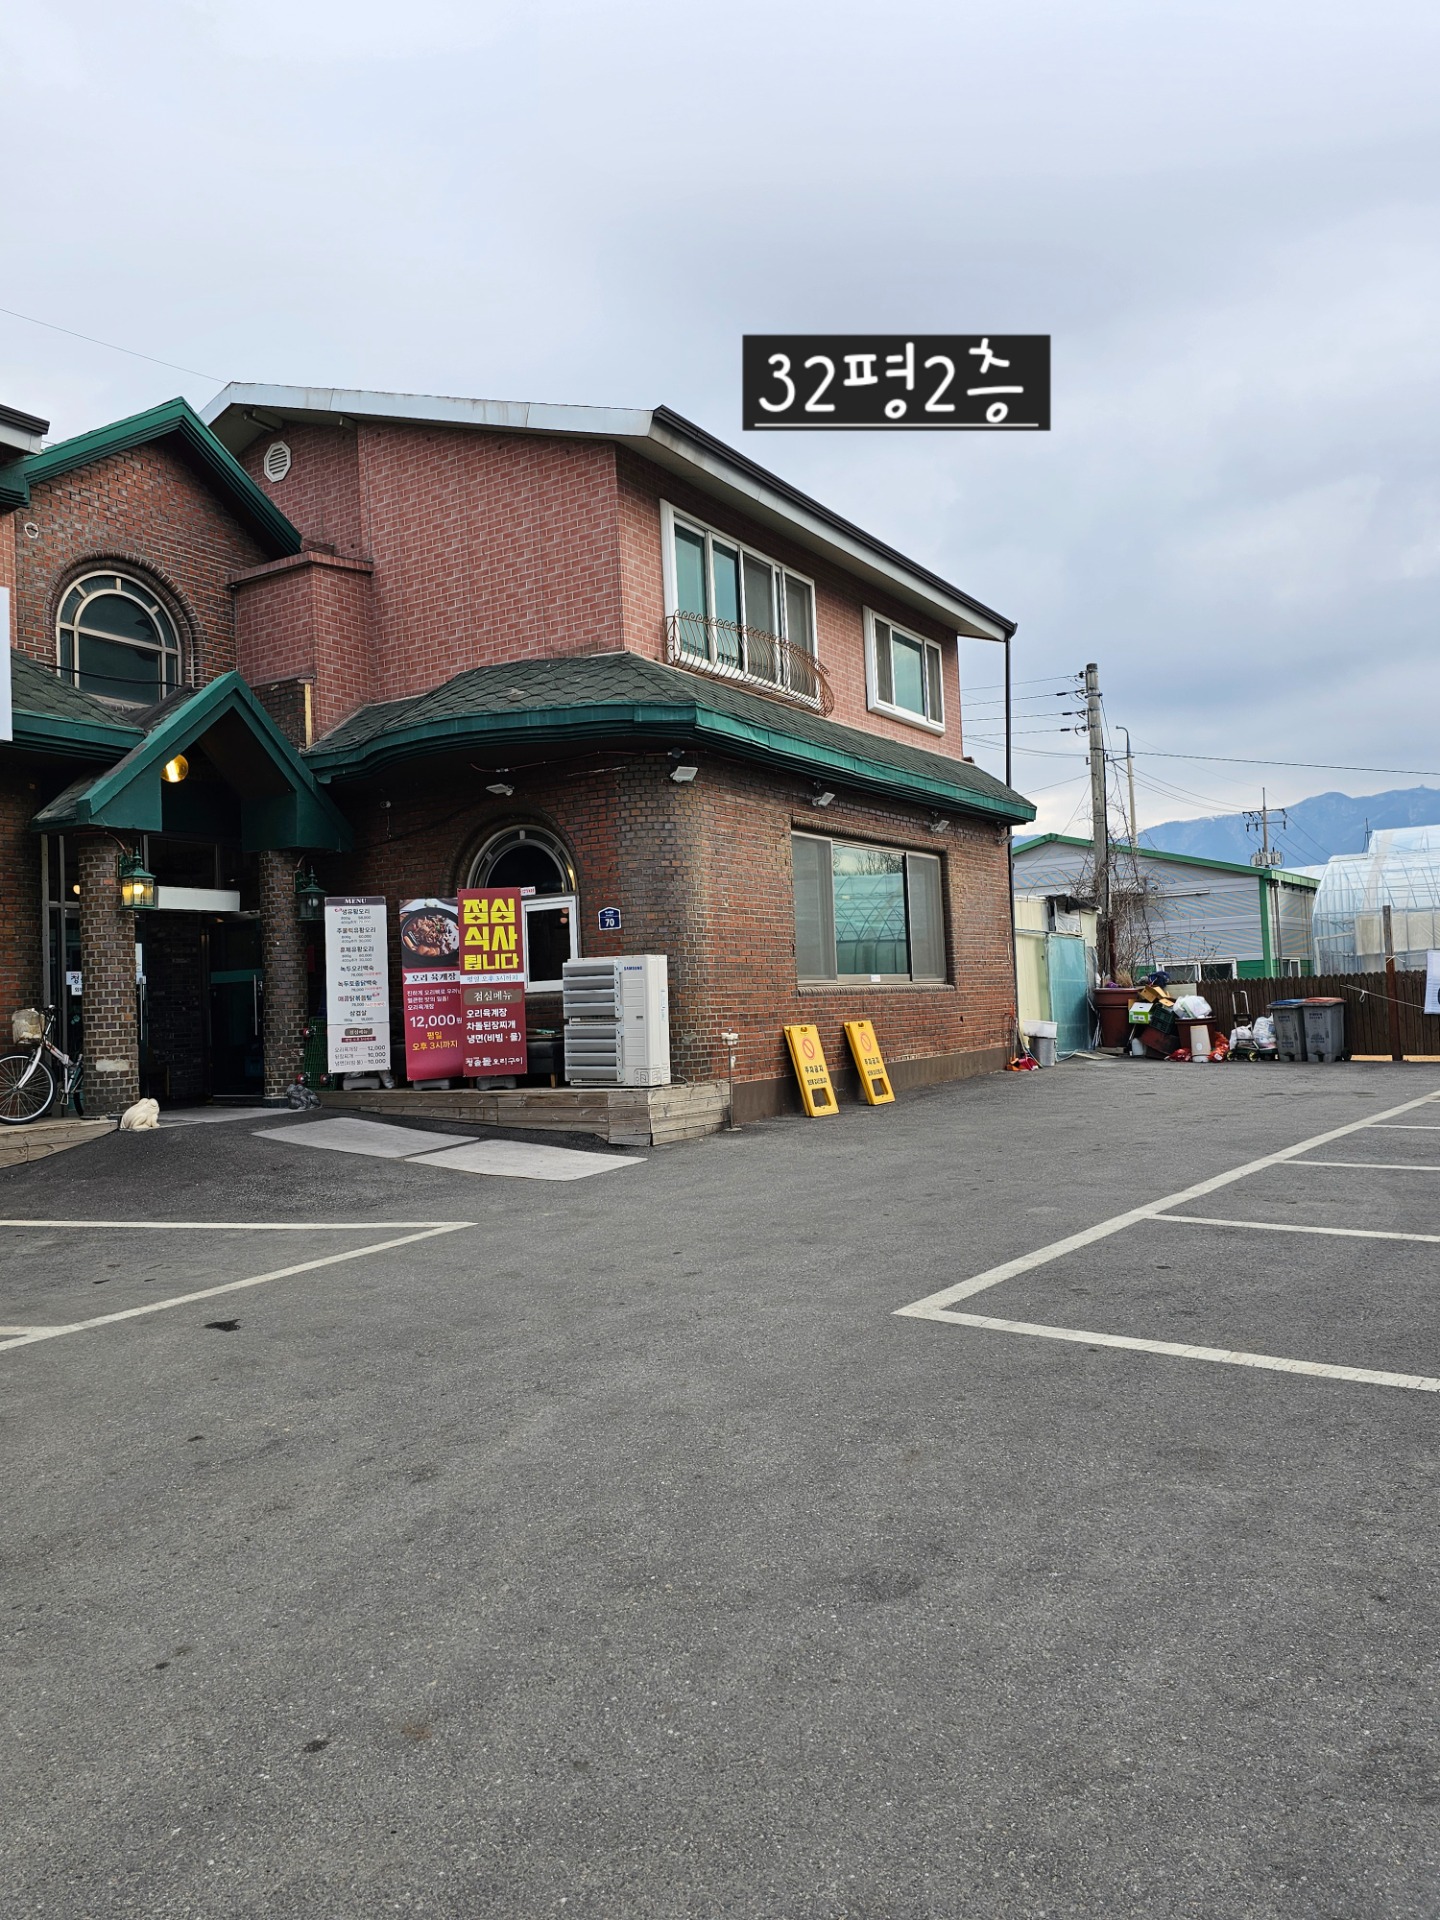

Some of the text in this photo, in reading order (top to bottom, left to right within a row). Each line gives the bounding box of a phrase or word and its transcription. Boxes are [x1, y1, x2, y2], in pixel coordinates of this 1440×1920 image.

[463, 898, 515, 924] 점심
[605, 918, 615, 927] 70
[464, 925, 518, 951] 식사
[464, 953, 519, 970] 됩니다
[412, 974, 428, 982] 오리
[474, 990, 512, 1001] 점심메뉴
[466, 1020, 516, 1031] 차돌된장찌개
[427, 1031, 443, 1040] 평일
[412, 1040, 458, 1051] 오후 3시까지
[804, 1064, 824, 1074] 주차금지
